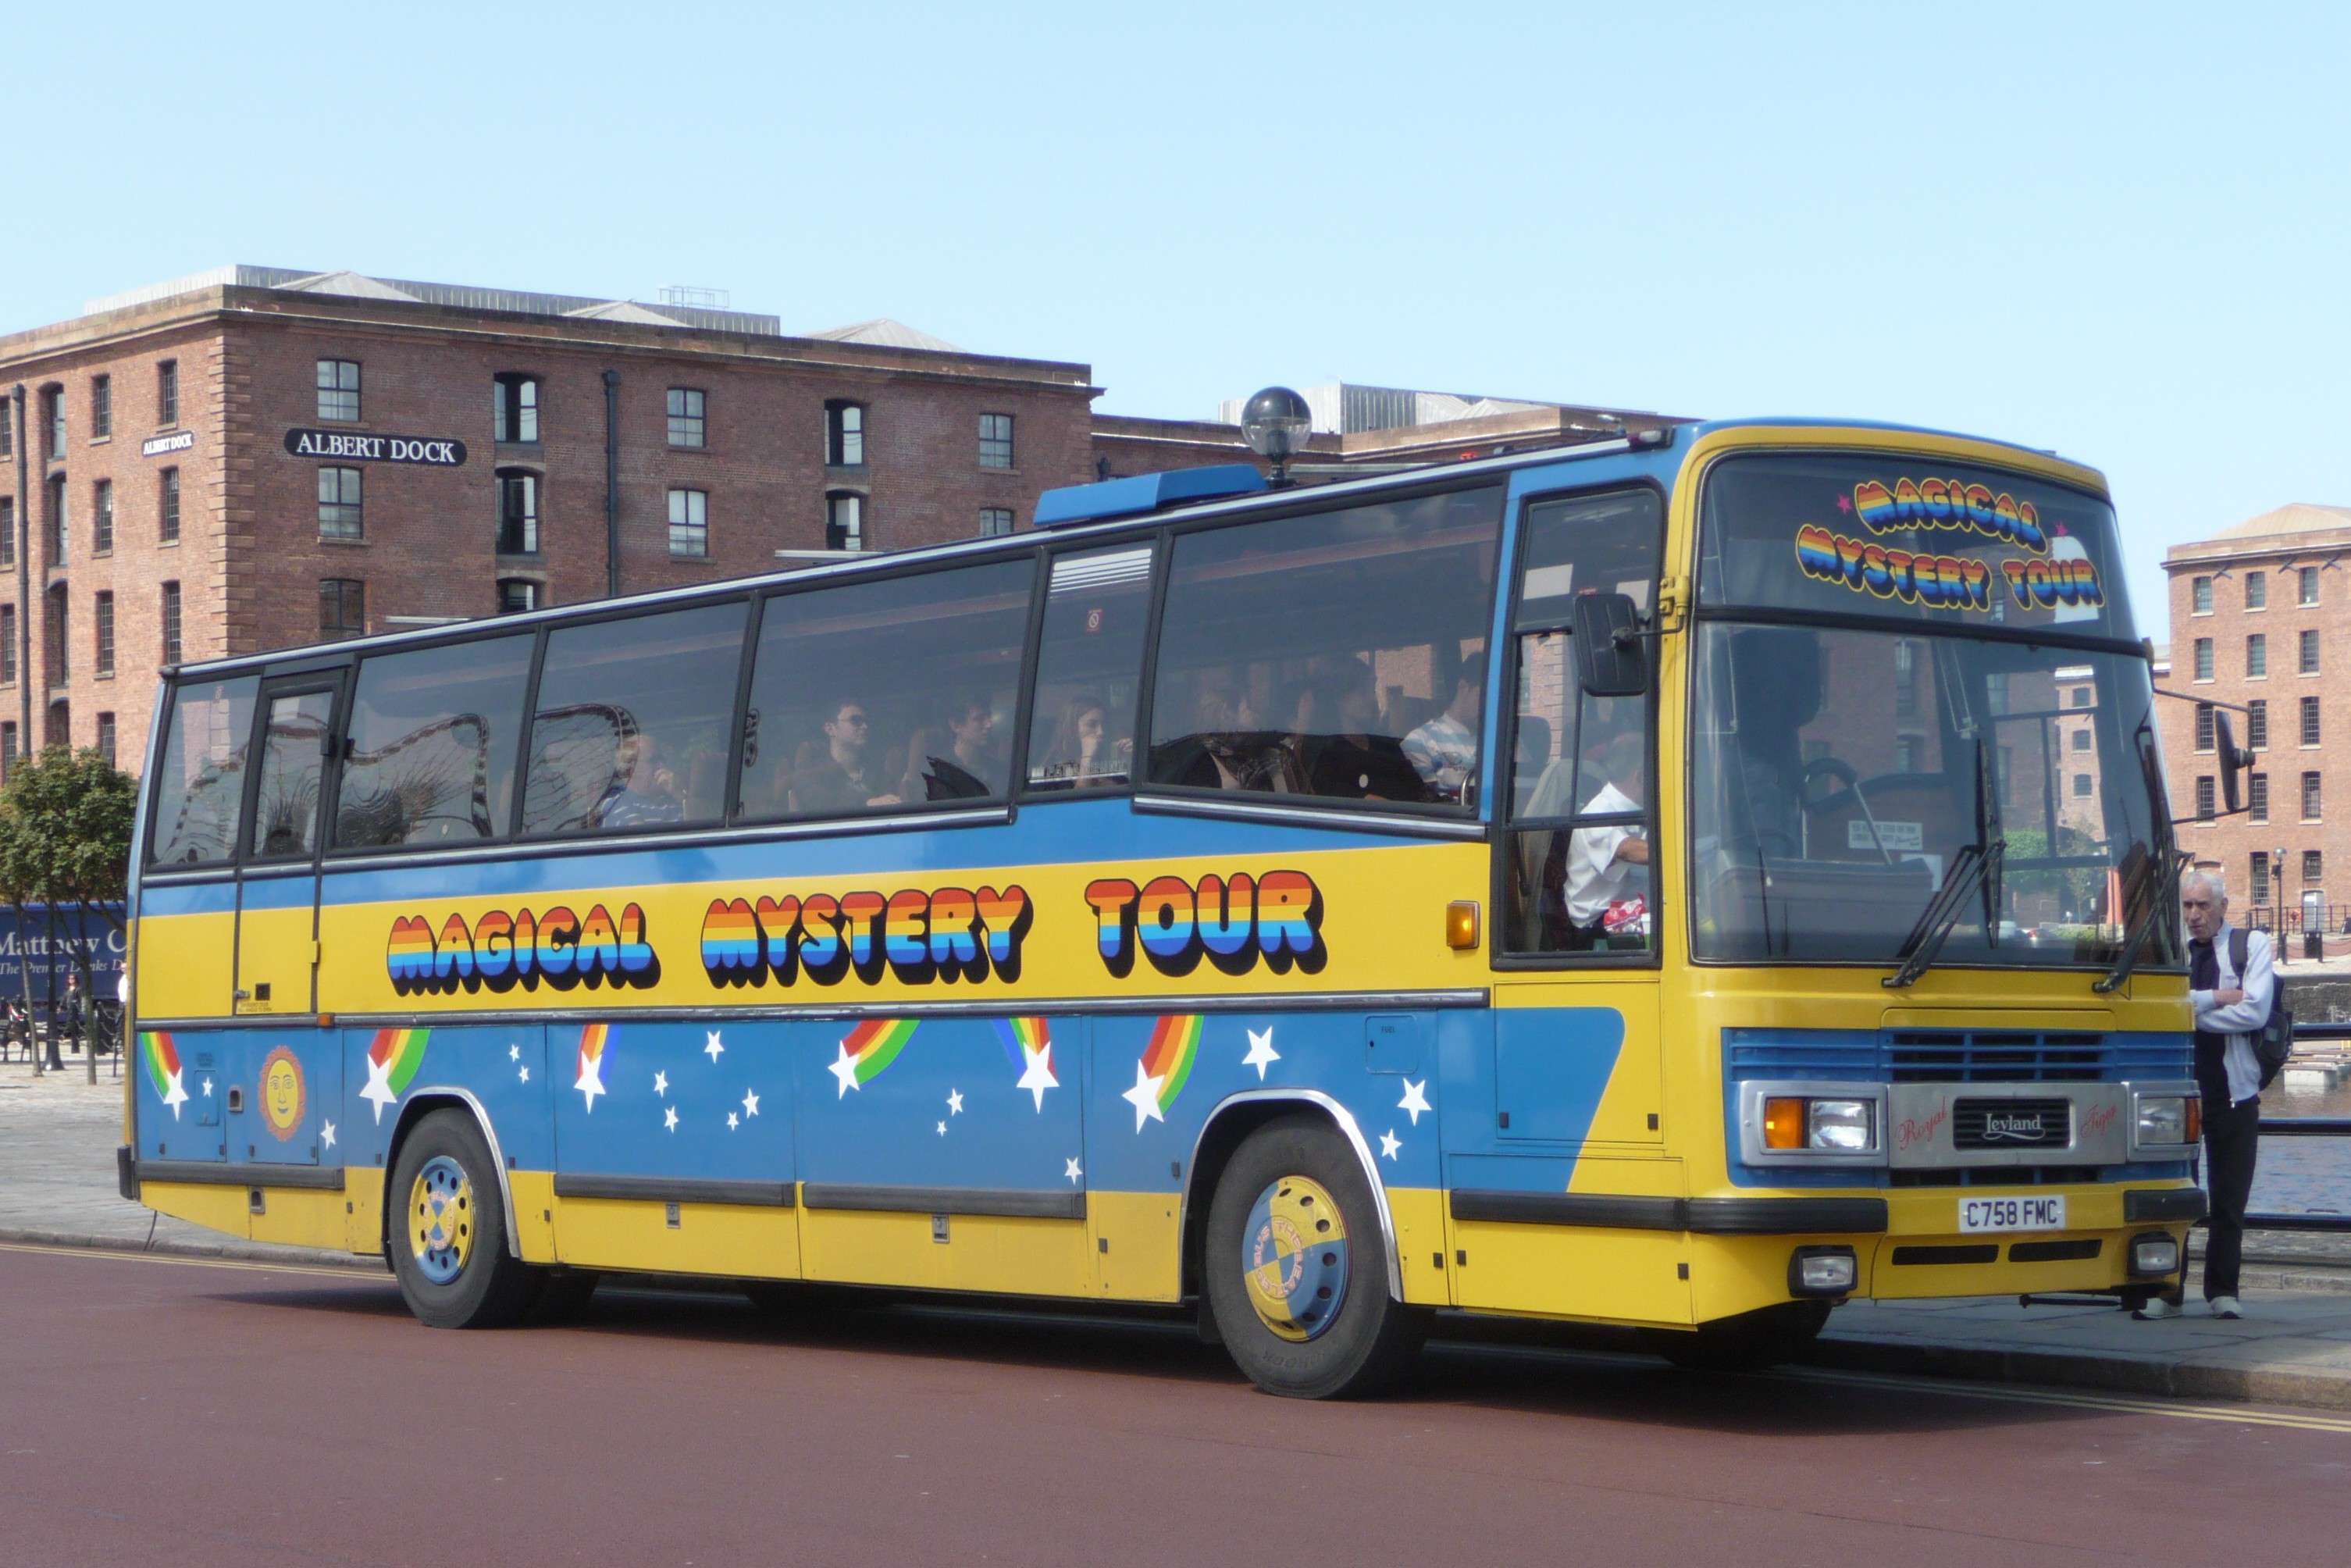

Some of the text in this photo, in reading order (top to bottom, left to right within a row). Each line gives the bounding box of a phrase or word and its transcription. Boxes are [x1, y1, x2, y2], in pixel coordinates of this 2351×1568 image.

[170, 433, 193, 451] DOCK
[296, 433, 457, 463] ALBERT DOCK
[1854, 476, 2049, 555] MAGICAL
[1796, 523, 2106, 613] MYSTERY TOUR
[387, 869, 1328, 997] MAGICAL MYSTERY TOUR
[27, 961, 67, 975] remer
[1896, 1096, 1949, 1151] Royal
[1983, 1113, 2044, 1139] Leyland
[1966, 1199, 2058, 1228] C758 FMC
